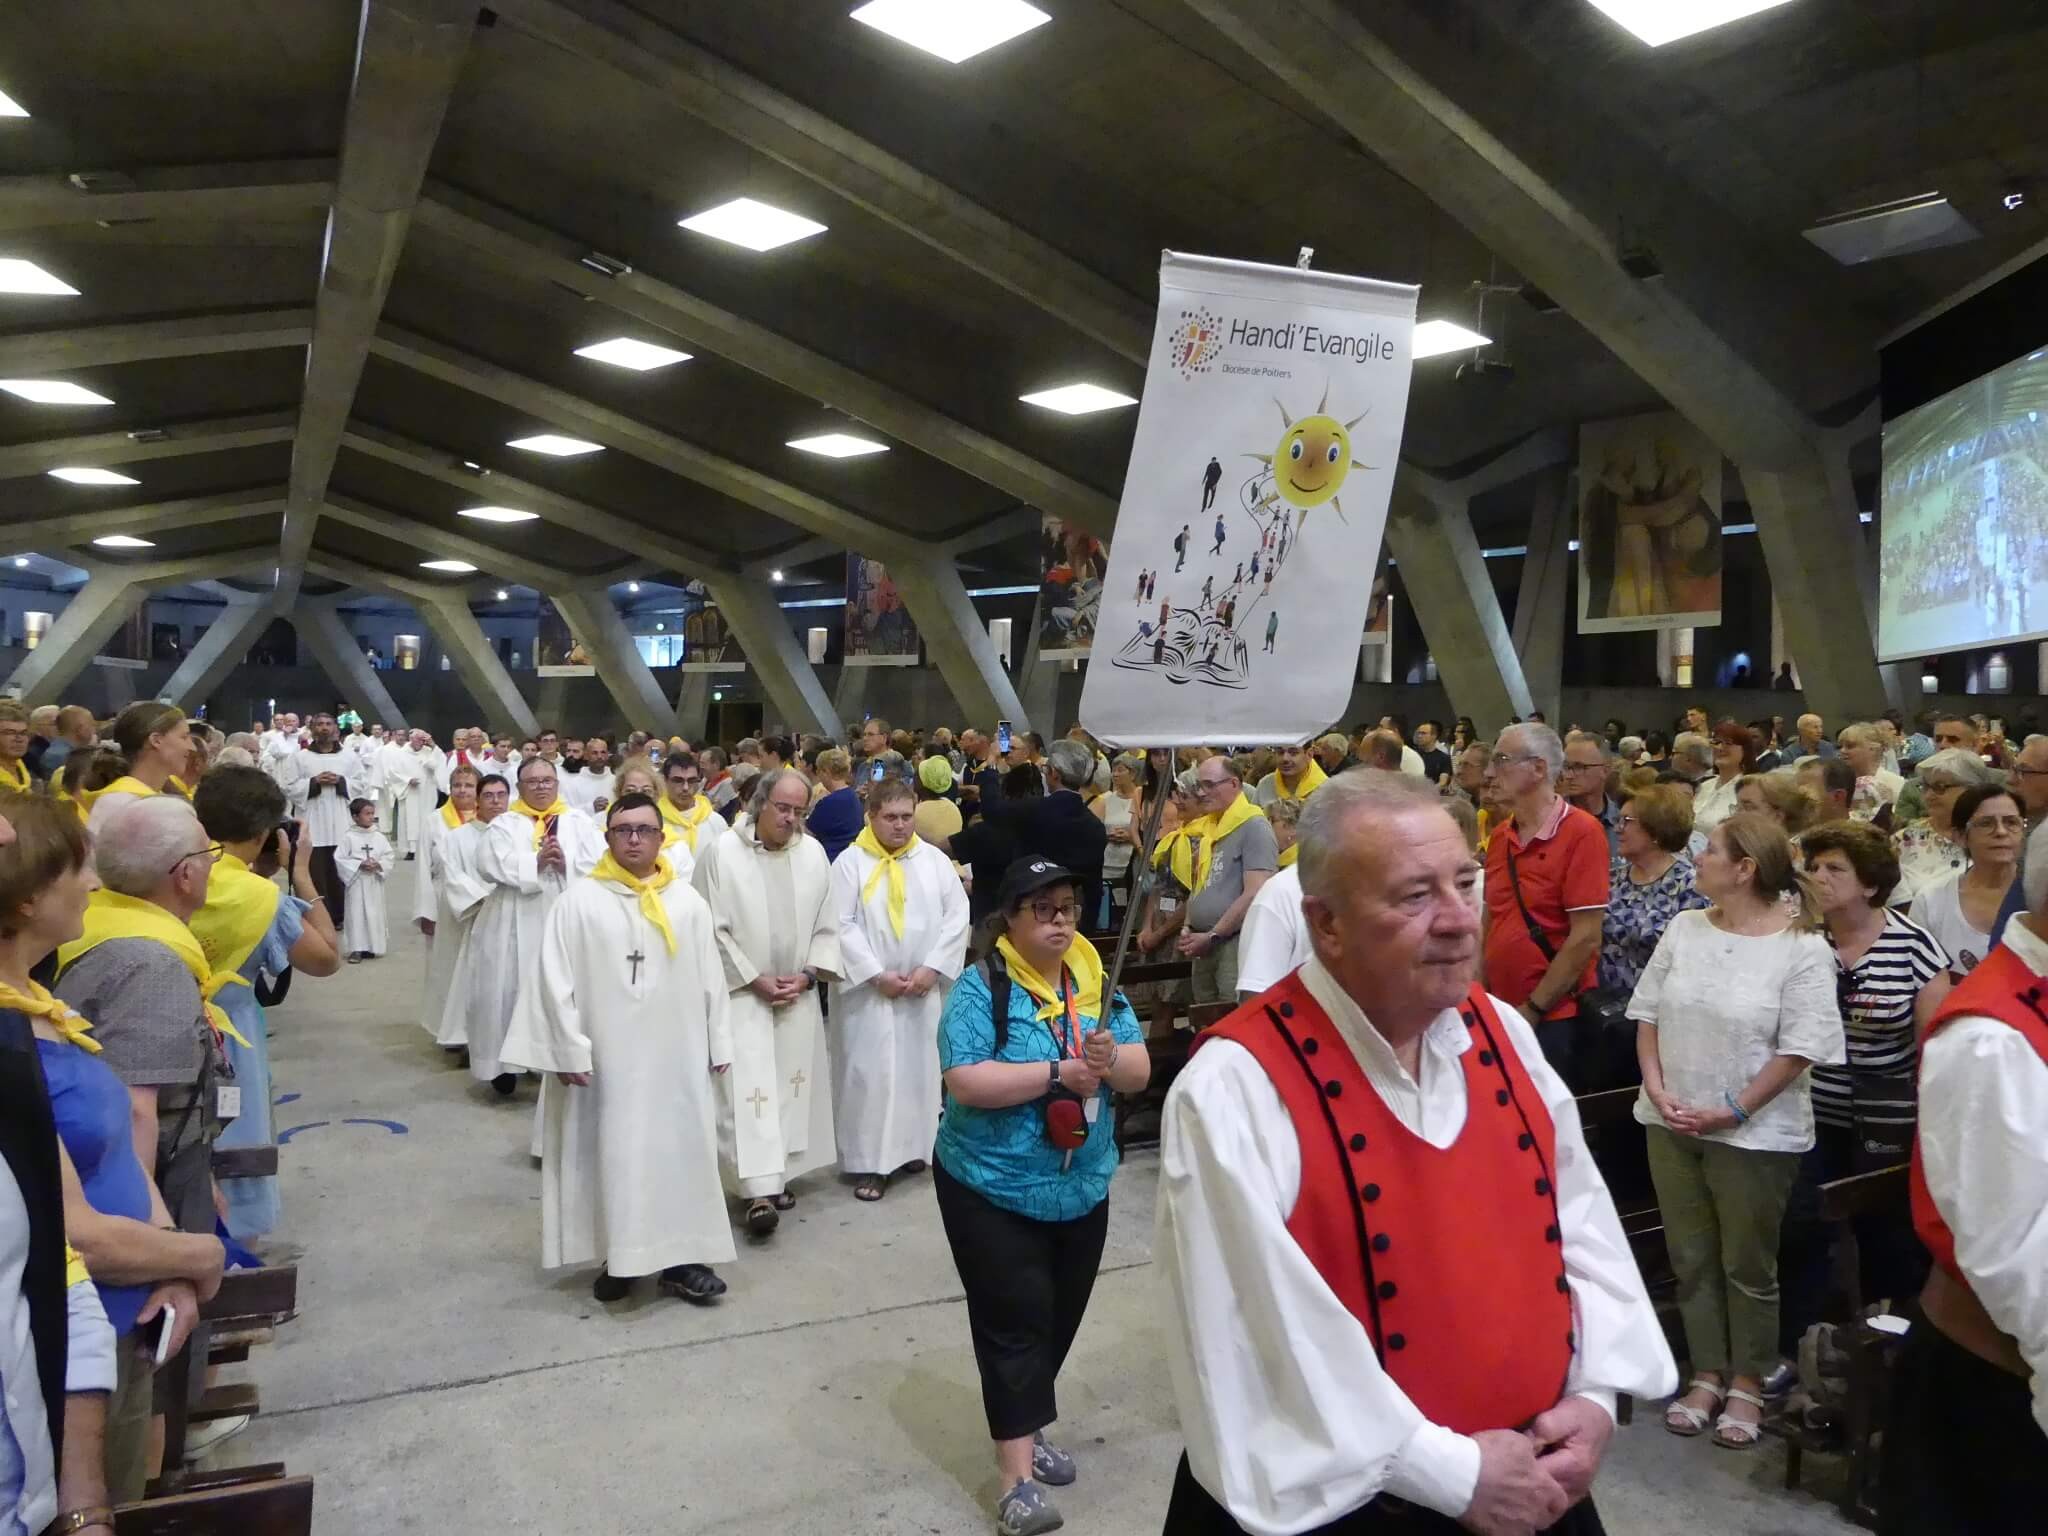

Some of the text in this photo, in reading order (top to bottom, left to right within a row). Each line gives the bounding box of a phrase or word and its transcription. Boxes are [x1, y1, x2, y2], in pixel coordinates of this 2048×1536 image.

[1229, 318, 1395, 364] Handi'Evangile
[1251, 367, 1261, 376] de
[1262, 367, 1292, 379] Poitiers
